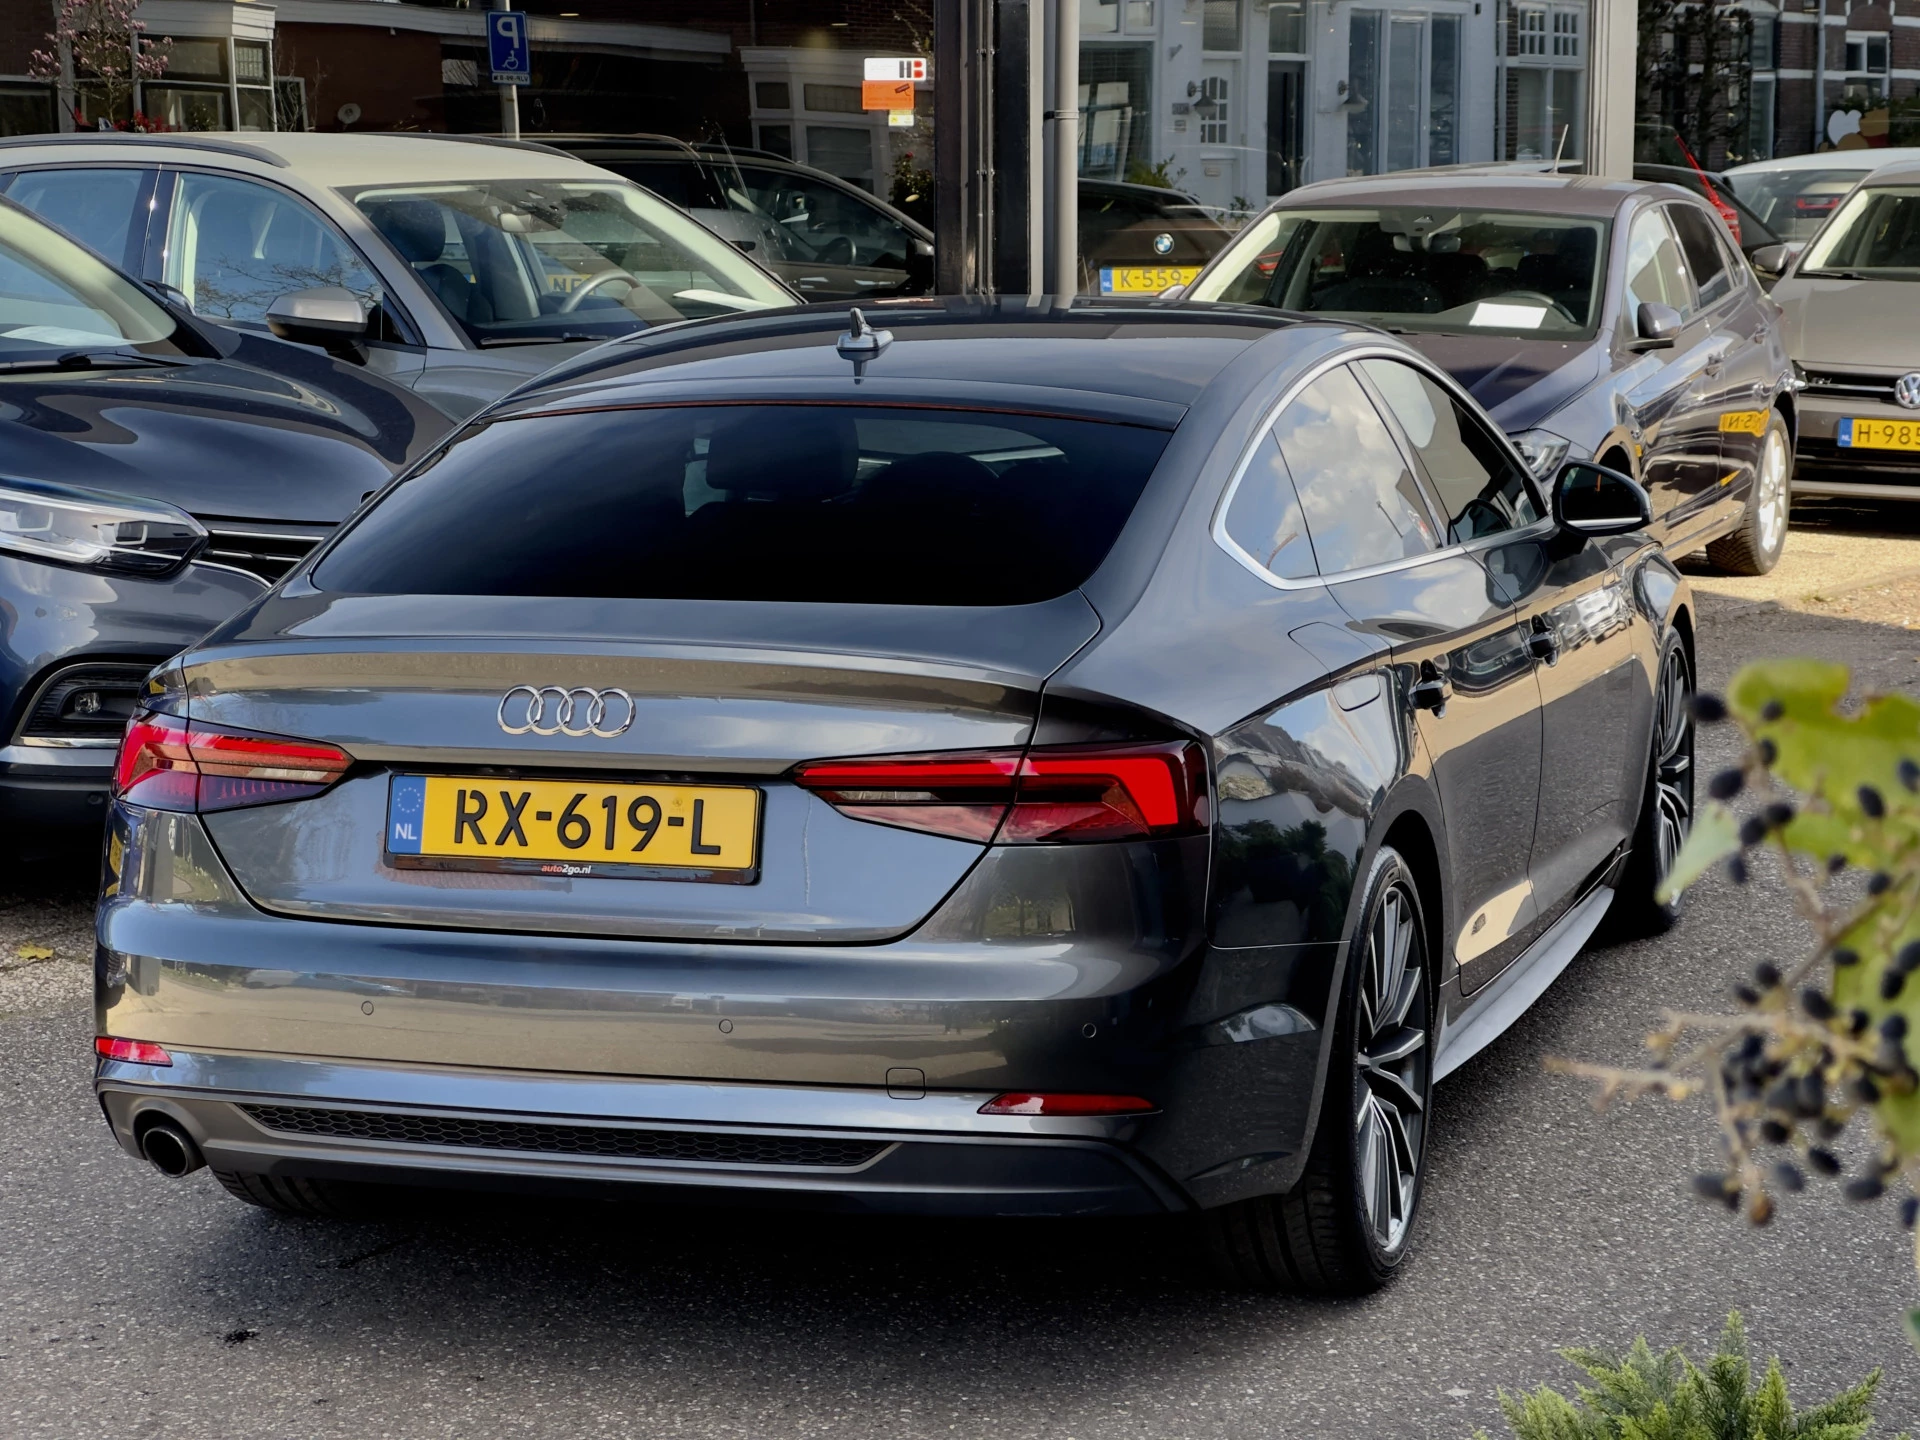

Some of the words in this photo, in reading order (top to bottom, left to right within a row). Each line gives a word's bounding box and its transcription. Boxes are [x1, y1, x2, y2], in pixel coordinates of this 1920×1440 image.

[1121, 267, 1200, 288] K-559-
[394, 822, 418, 840] NL
[454, 789, 721, 856] RX-619-L
[541, 864, 592, 875] auto2go.nl
